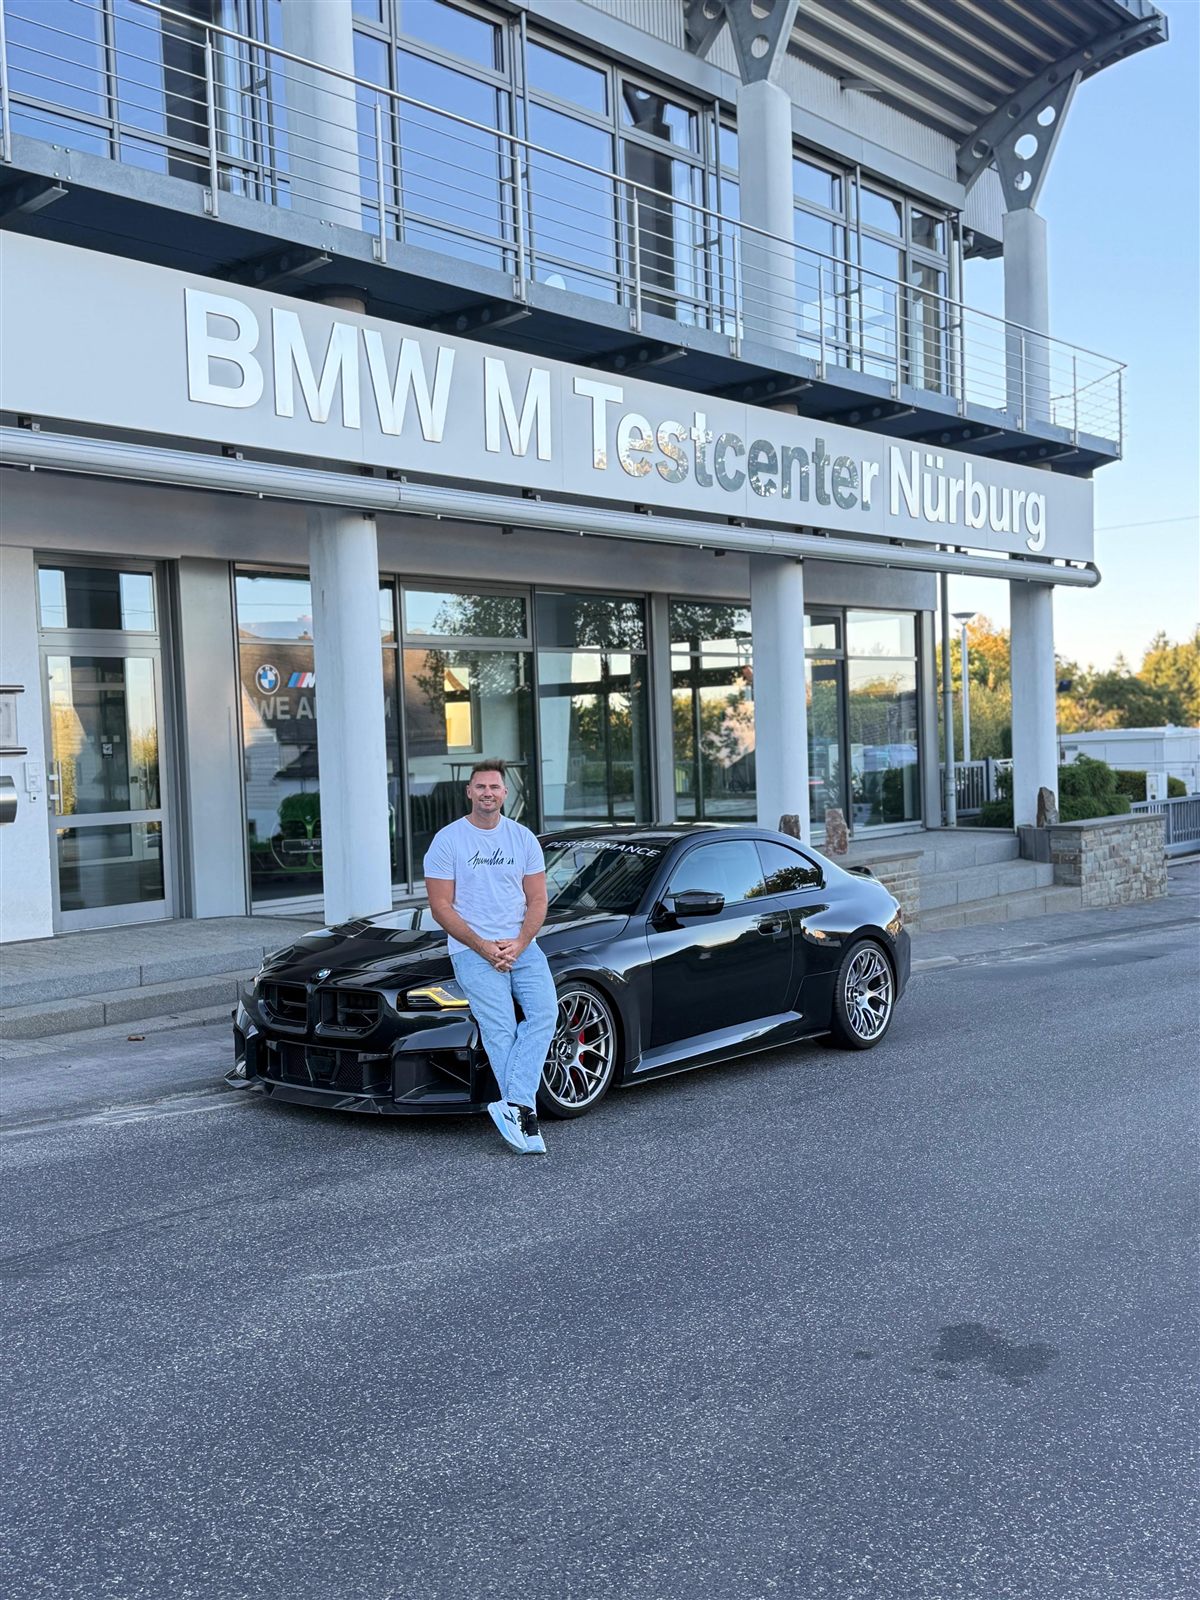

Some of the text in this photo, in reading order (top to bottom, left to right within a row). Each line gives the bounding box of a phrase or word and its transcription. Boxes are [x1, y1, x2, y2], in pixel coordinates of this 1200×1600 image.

[184, 287, 1047, 553] BMW M Testcenter Nürburg
[253, 696, 291, 720] WE
[545, 840, 661, 858] PERFORMANCE
